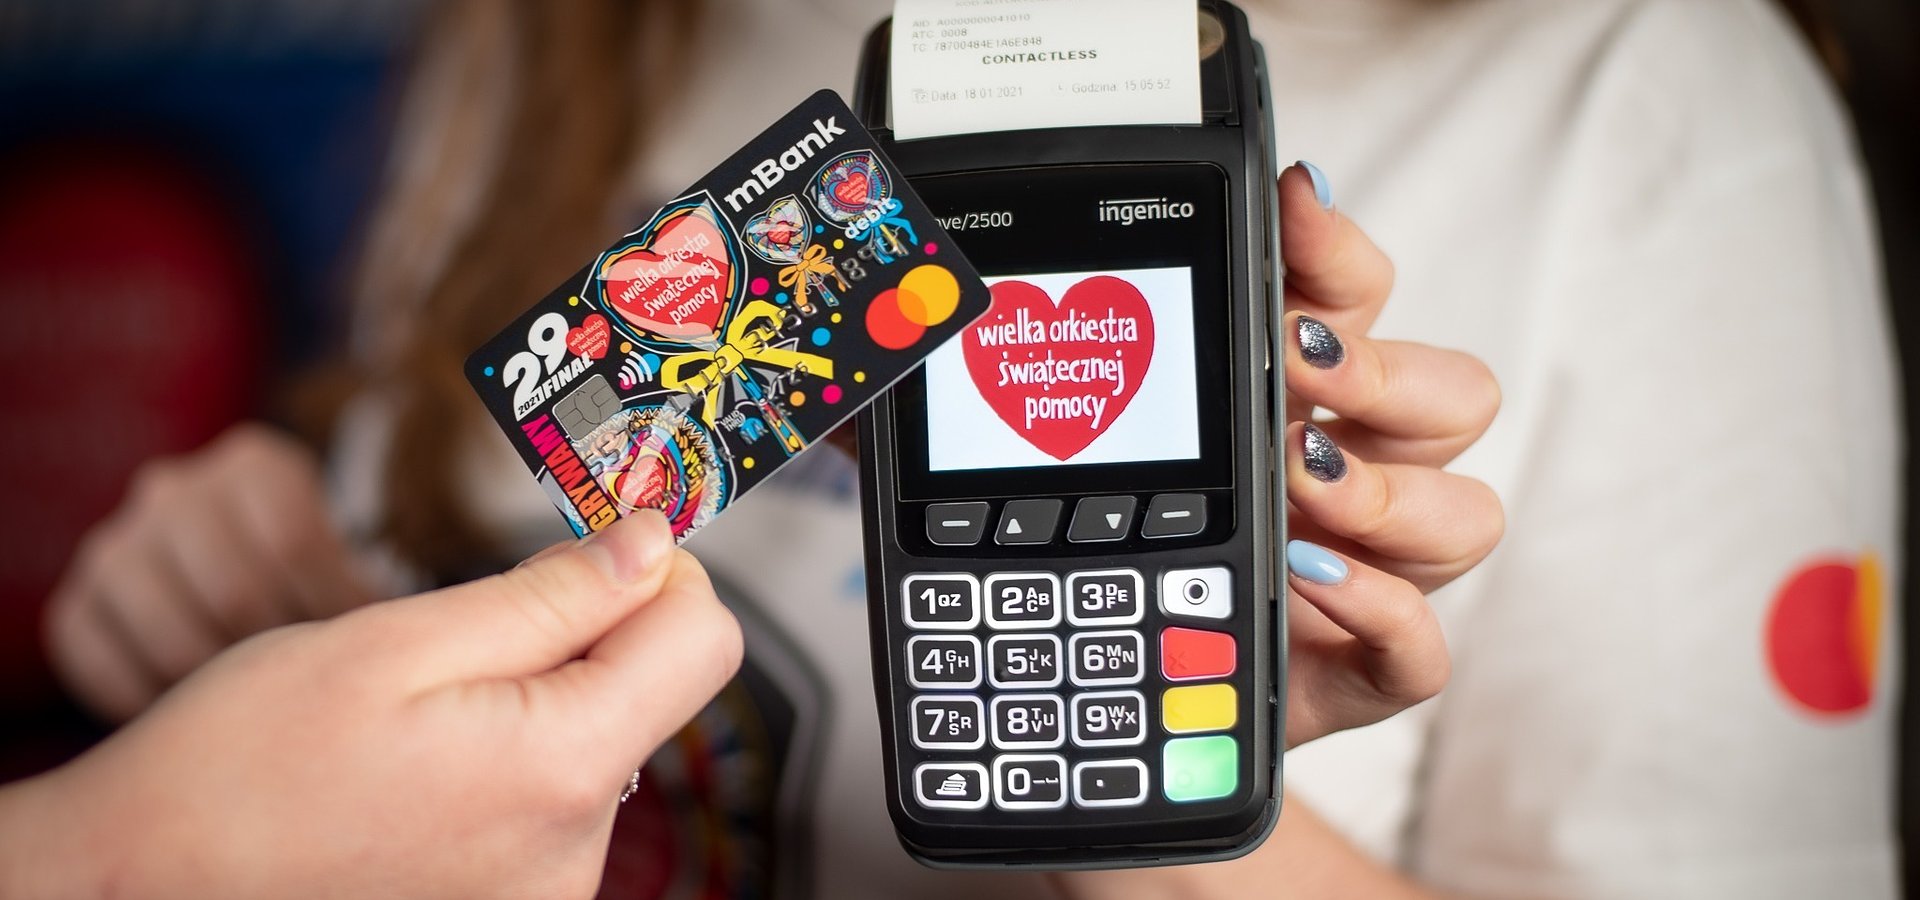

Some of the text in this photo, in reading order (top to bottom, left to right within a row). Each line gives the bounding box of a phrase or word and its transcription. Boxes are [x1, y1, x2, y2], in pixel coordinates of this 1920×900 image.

[941, 27, 968, 38] 0008
[981, 49, 1098, 66] CONTACTLESS
[723, 116, 846, 213] mBank
[844, 197, 897, 240] debit
[935, 212, 1013, 232] ve/2500
[1099, 197, 1195, 226] ingenico
[619, 232, 711, 304] wielka orkiestra
[641, 253, 721, 317] świątecznej
[668, 284, 719, 328] pomocy
[976, 307, 1138, 347] wielka orkiestra
[502, 312, 570, 422] 29
[997, 349, 1126, 397] świątecznej
[518, 393, 540, 416] 2021
[1024, 393, 1107, 430] pomocy
